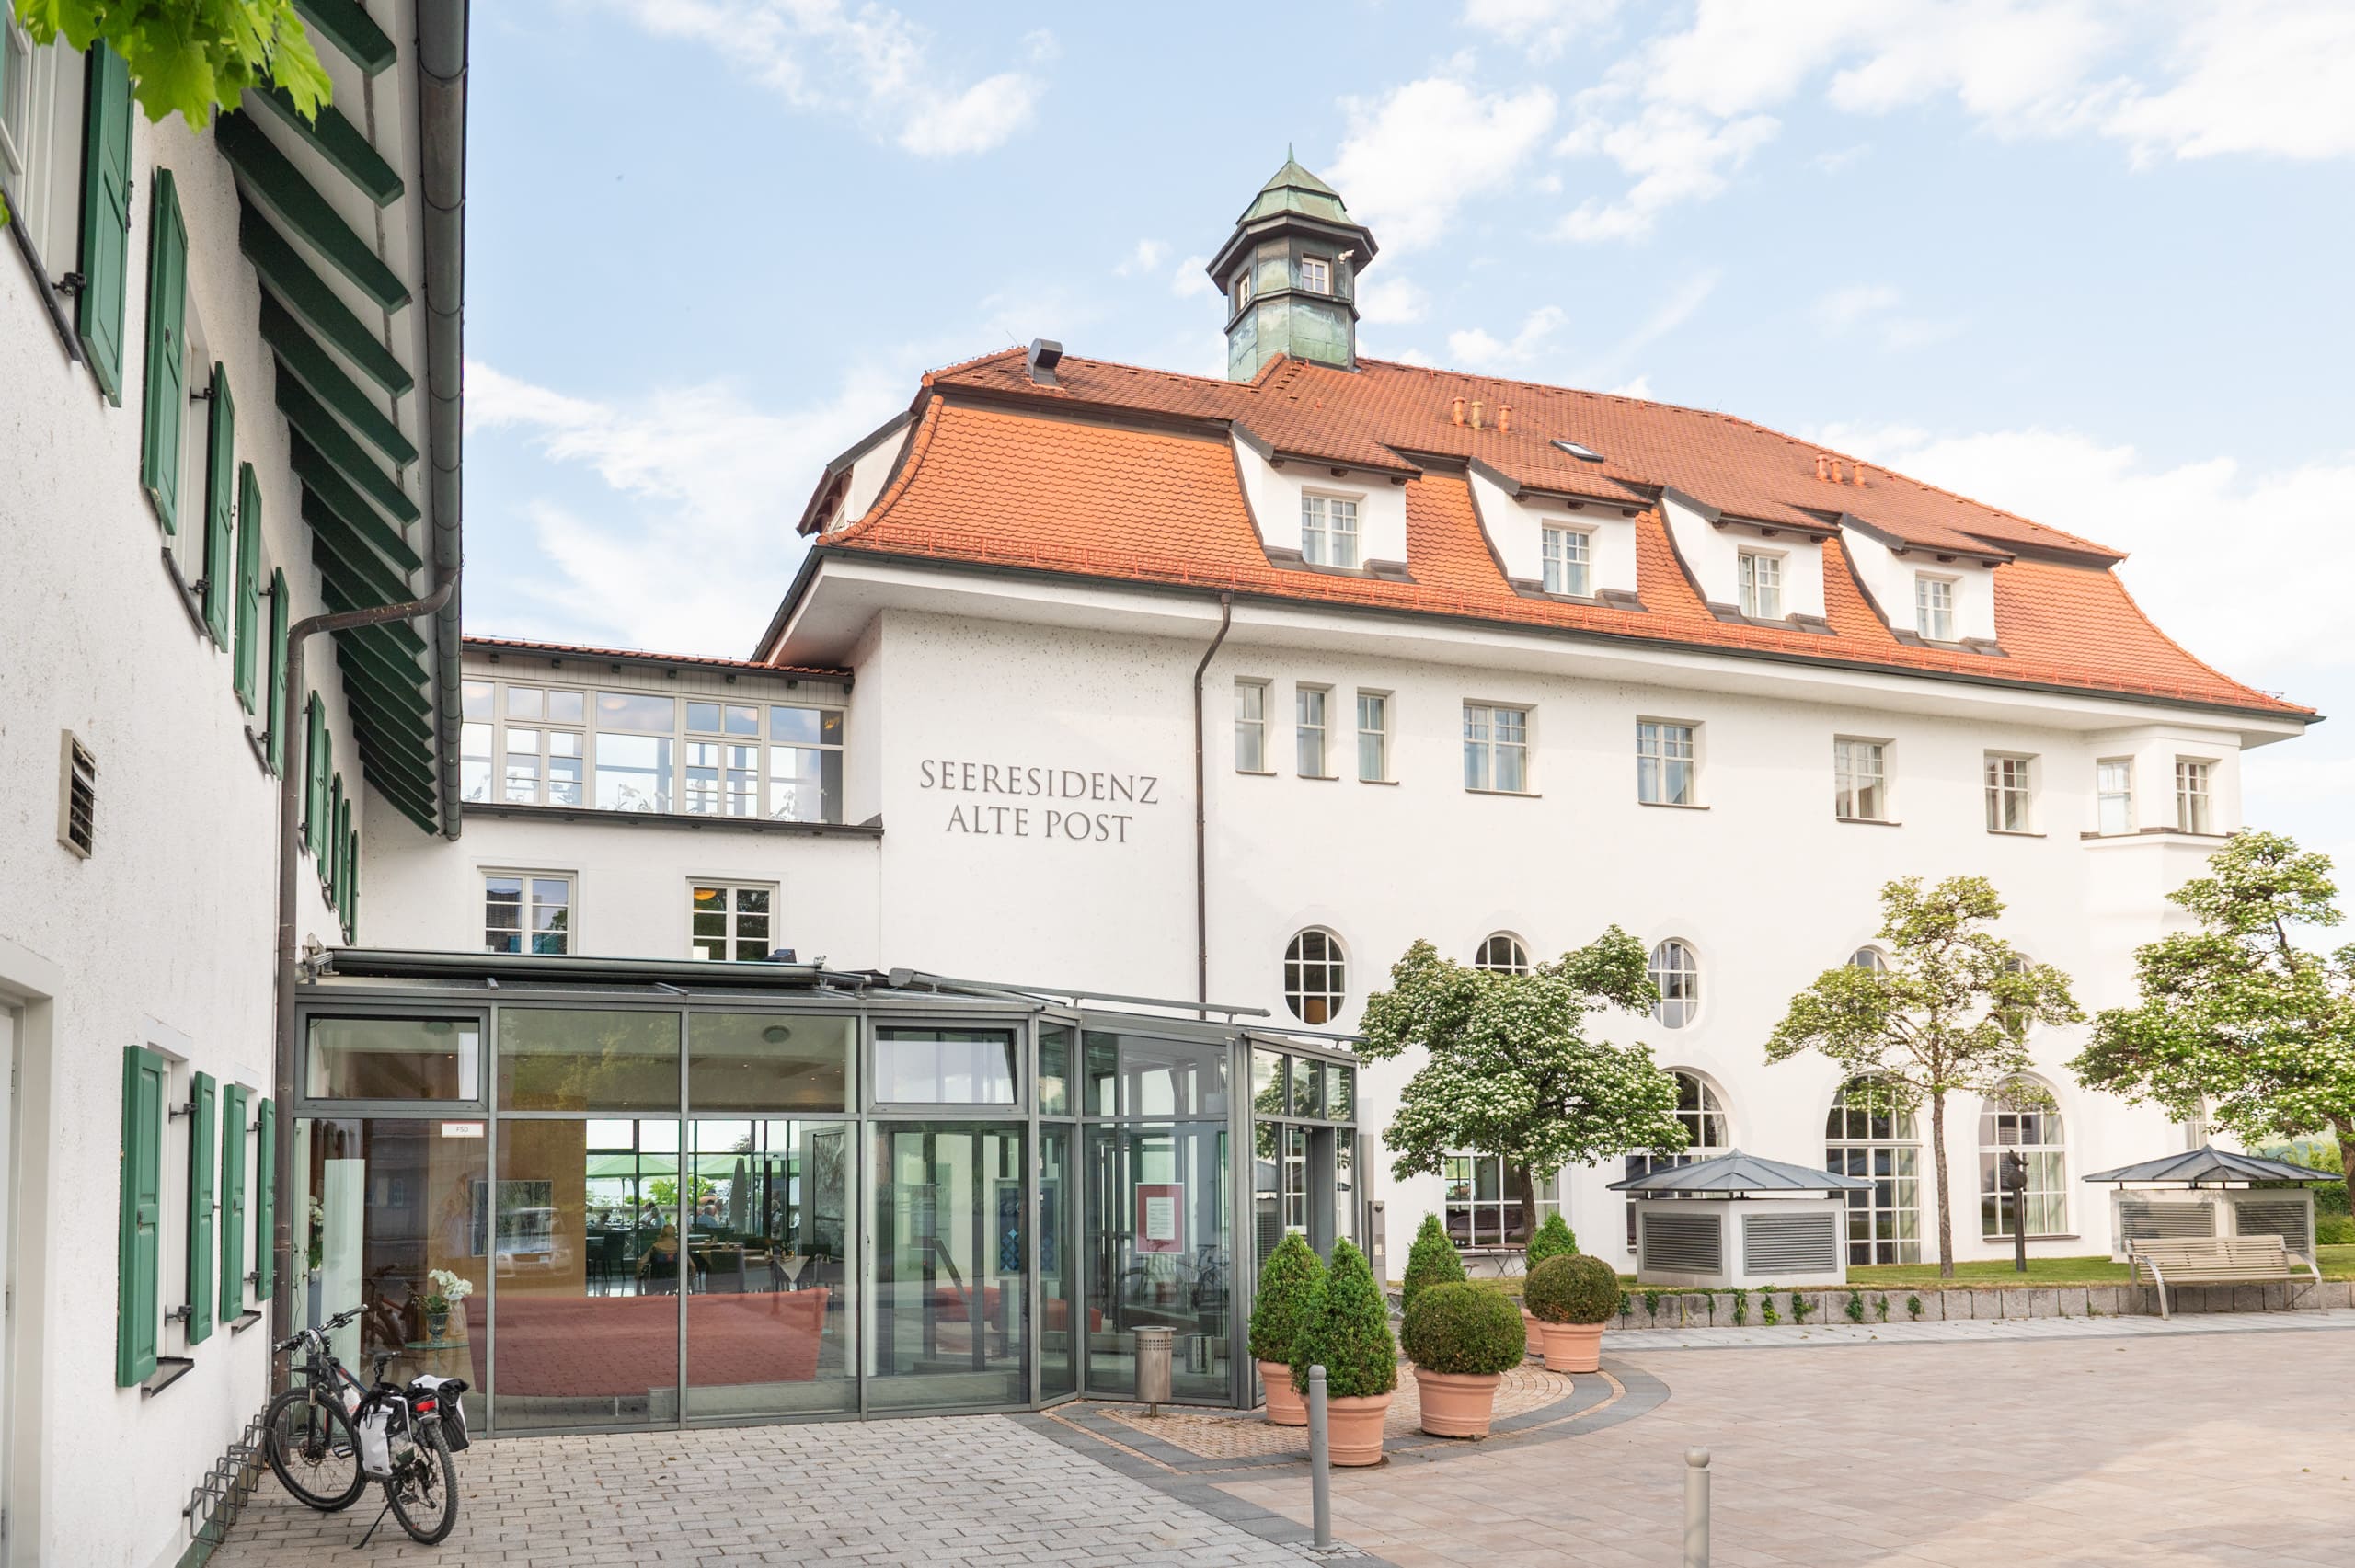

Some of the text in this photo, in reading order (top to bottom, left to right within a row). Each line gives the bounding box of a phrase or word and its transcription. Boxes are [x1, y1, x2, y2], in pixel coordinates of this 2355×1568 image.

[920, 760, 1158, 805] SEERESIDENZ
[947, 805, 1132, 843] ALTE POST
